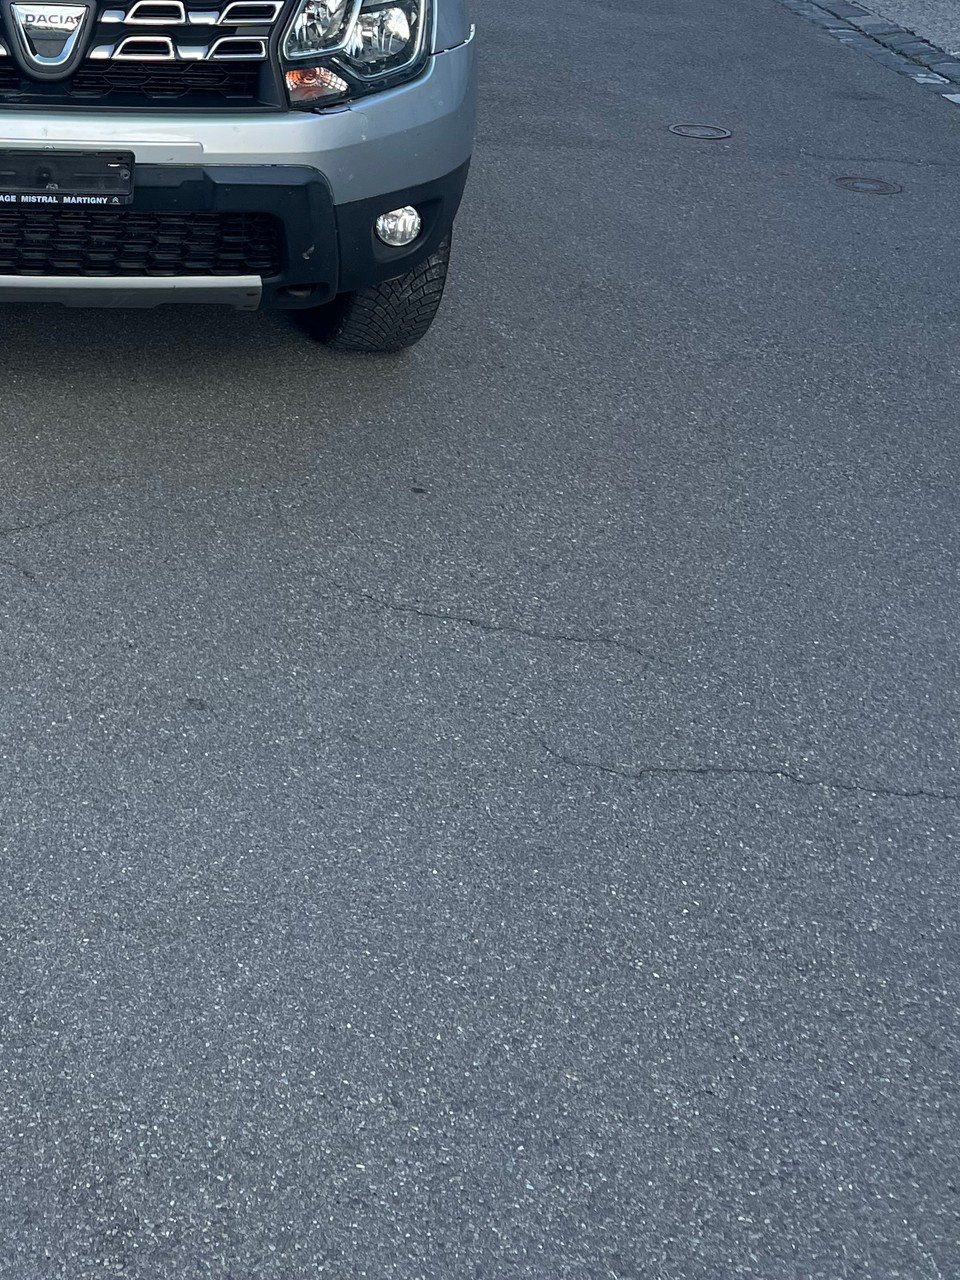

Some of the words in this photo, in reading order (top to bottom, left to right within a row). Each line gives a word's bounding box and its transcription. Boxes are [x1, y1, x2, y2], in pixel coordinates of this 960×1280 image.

[25, 14, 75, 25] DACIA
[20, 195, 59, 204] MISTRAL
[62, 196, 108, 204] MARTIGNY
